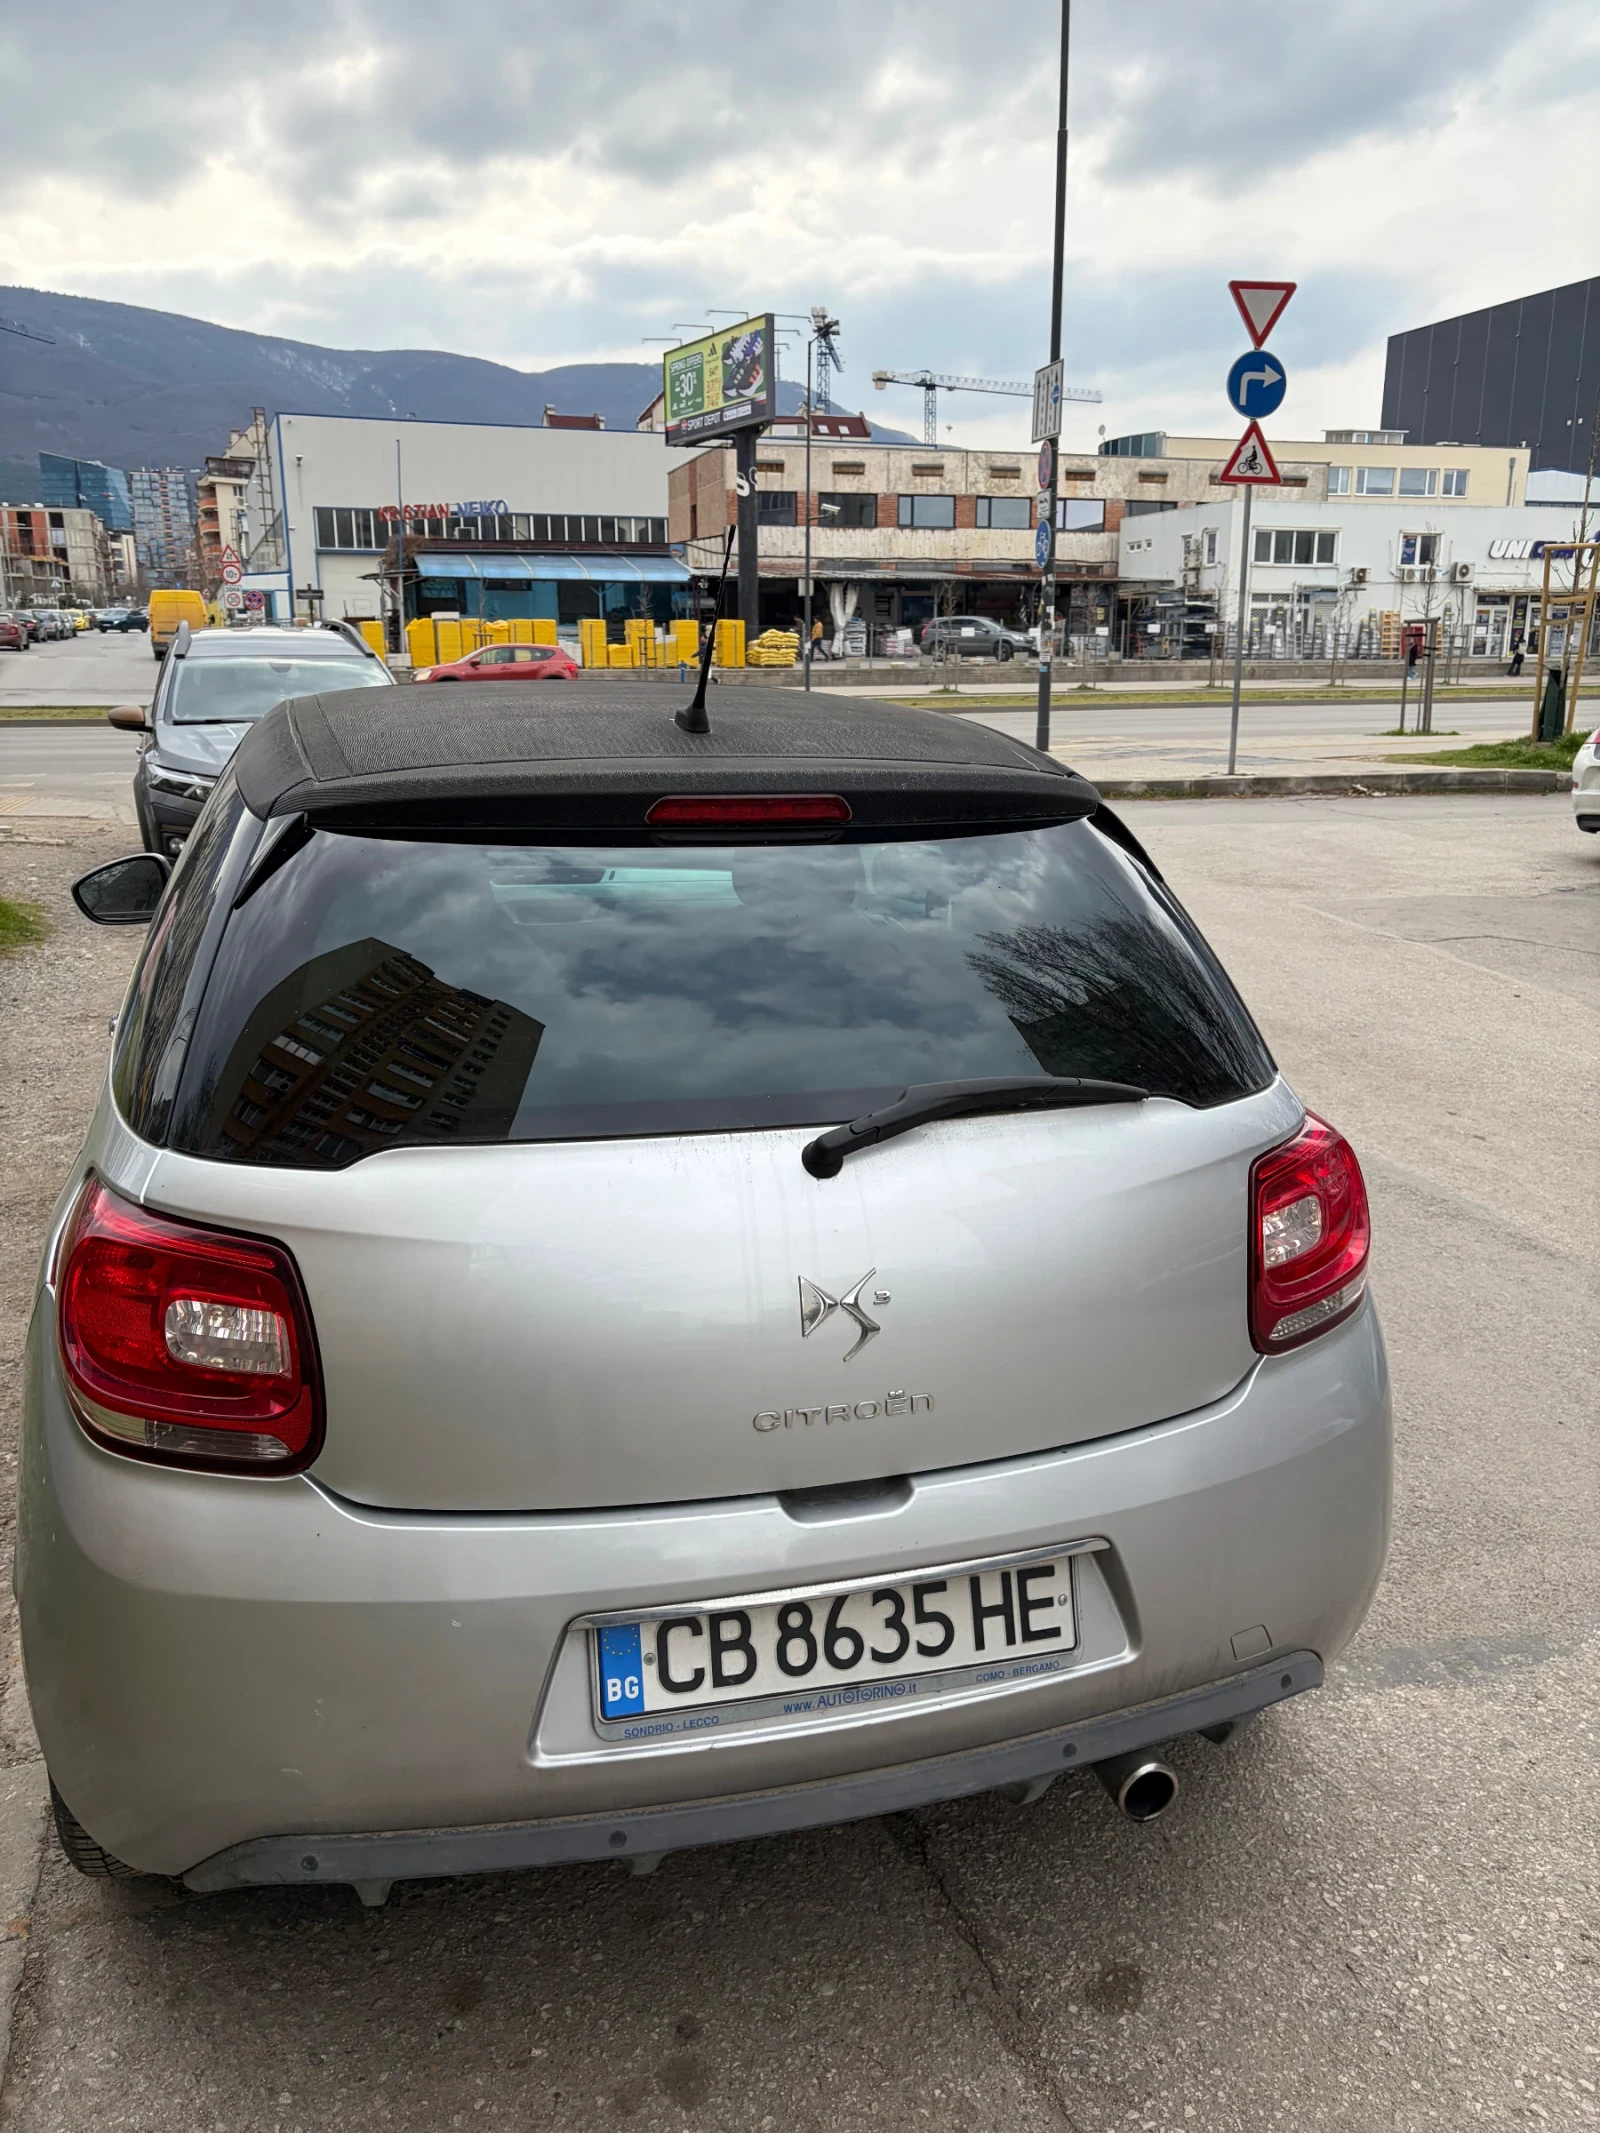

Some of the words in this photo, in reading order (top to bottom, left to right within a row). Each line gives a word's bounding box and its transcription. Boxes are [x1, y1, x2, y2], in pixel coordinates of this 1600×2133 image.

[687, 416, 703, 431] SPORT
[704, 411, 721, 426] DEPOT
[377, 503, 450, 521] KRSTIAN
[656, 1609, 757, 1694] CB
[776, 1580, 955, 1677] 8635
[969, 1565, 1061, 1651] HE
[976, 1670, 1005, 1683] COMO
[1013, 1660, 1060, 1676] BERGAMO
[606, 1676, 639, 1702] BG
[624, 1722, 673, 1739] SONDRIO
[683, 1715, 720, 1730] LECCO
